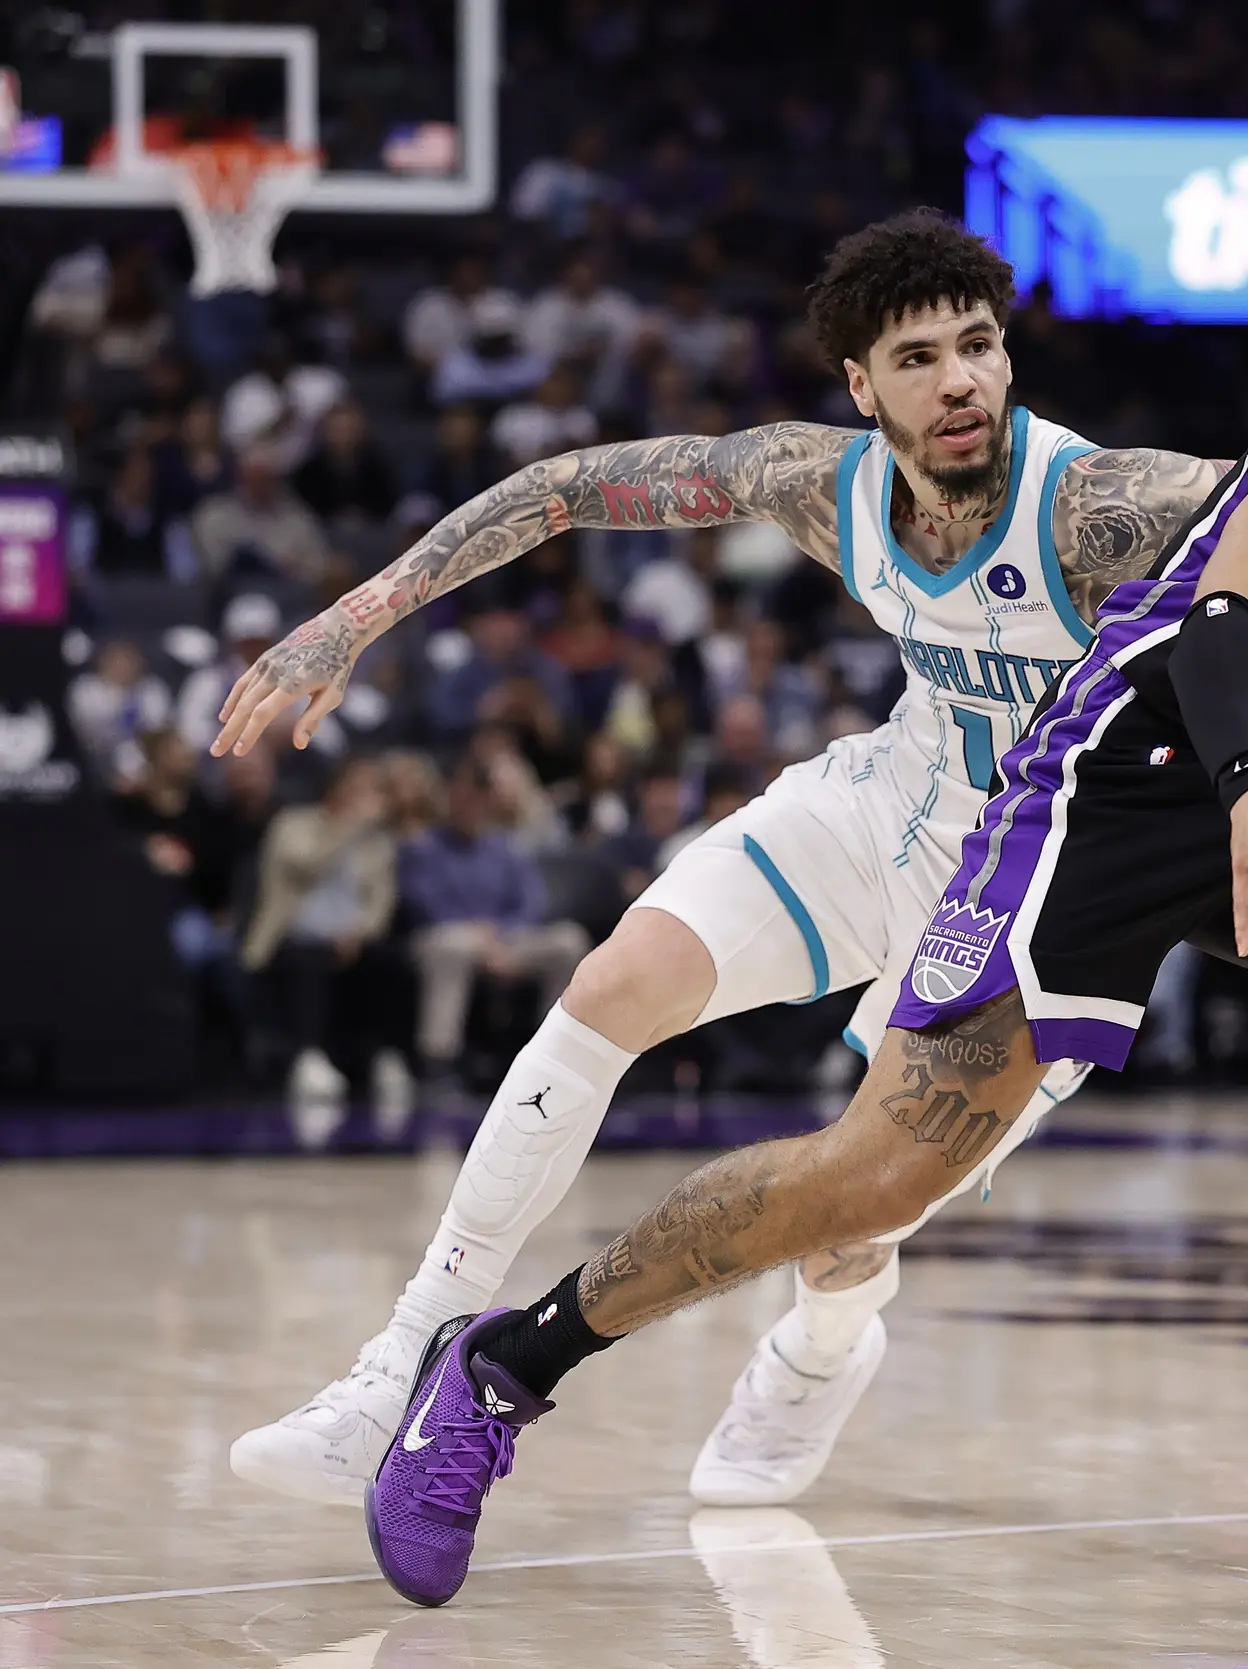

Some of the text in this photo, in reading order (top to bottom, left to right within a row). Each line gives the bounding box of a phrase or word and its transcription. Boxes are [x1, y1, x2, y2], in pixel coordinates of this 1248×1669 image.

[984, 600, 1049, 616] Judi Health
[928, 924, 990, 948] SACRAMENTO
[919, 937, 986, 971] KINGS
